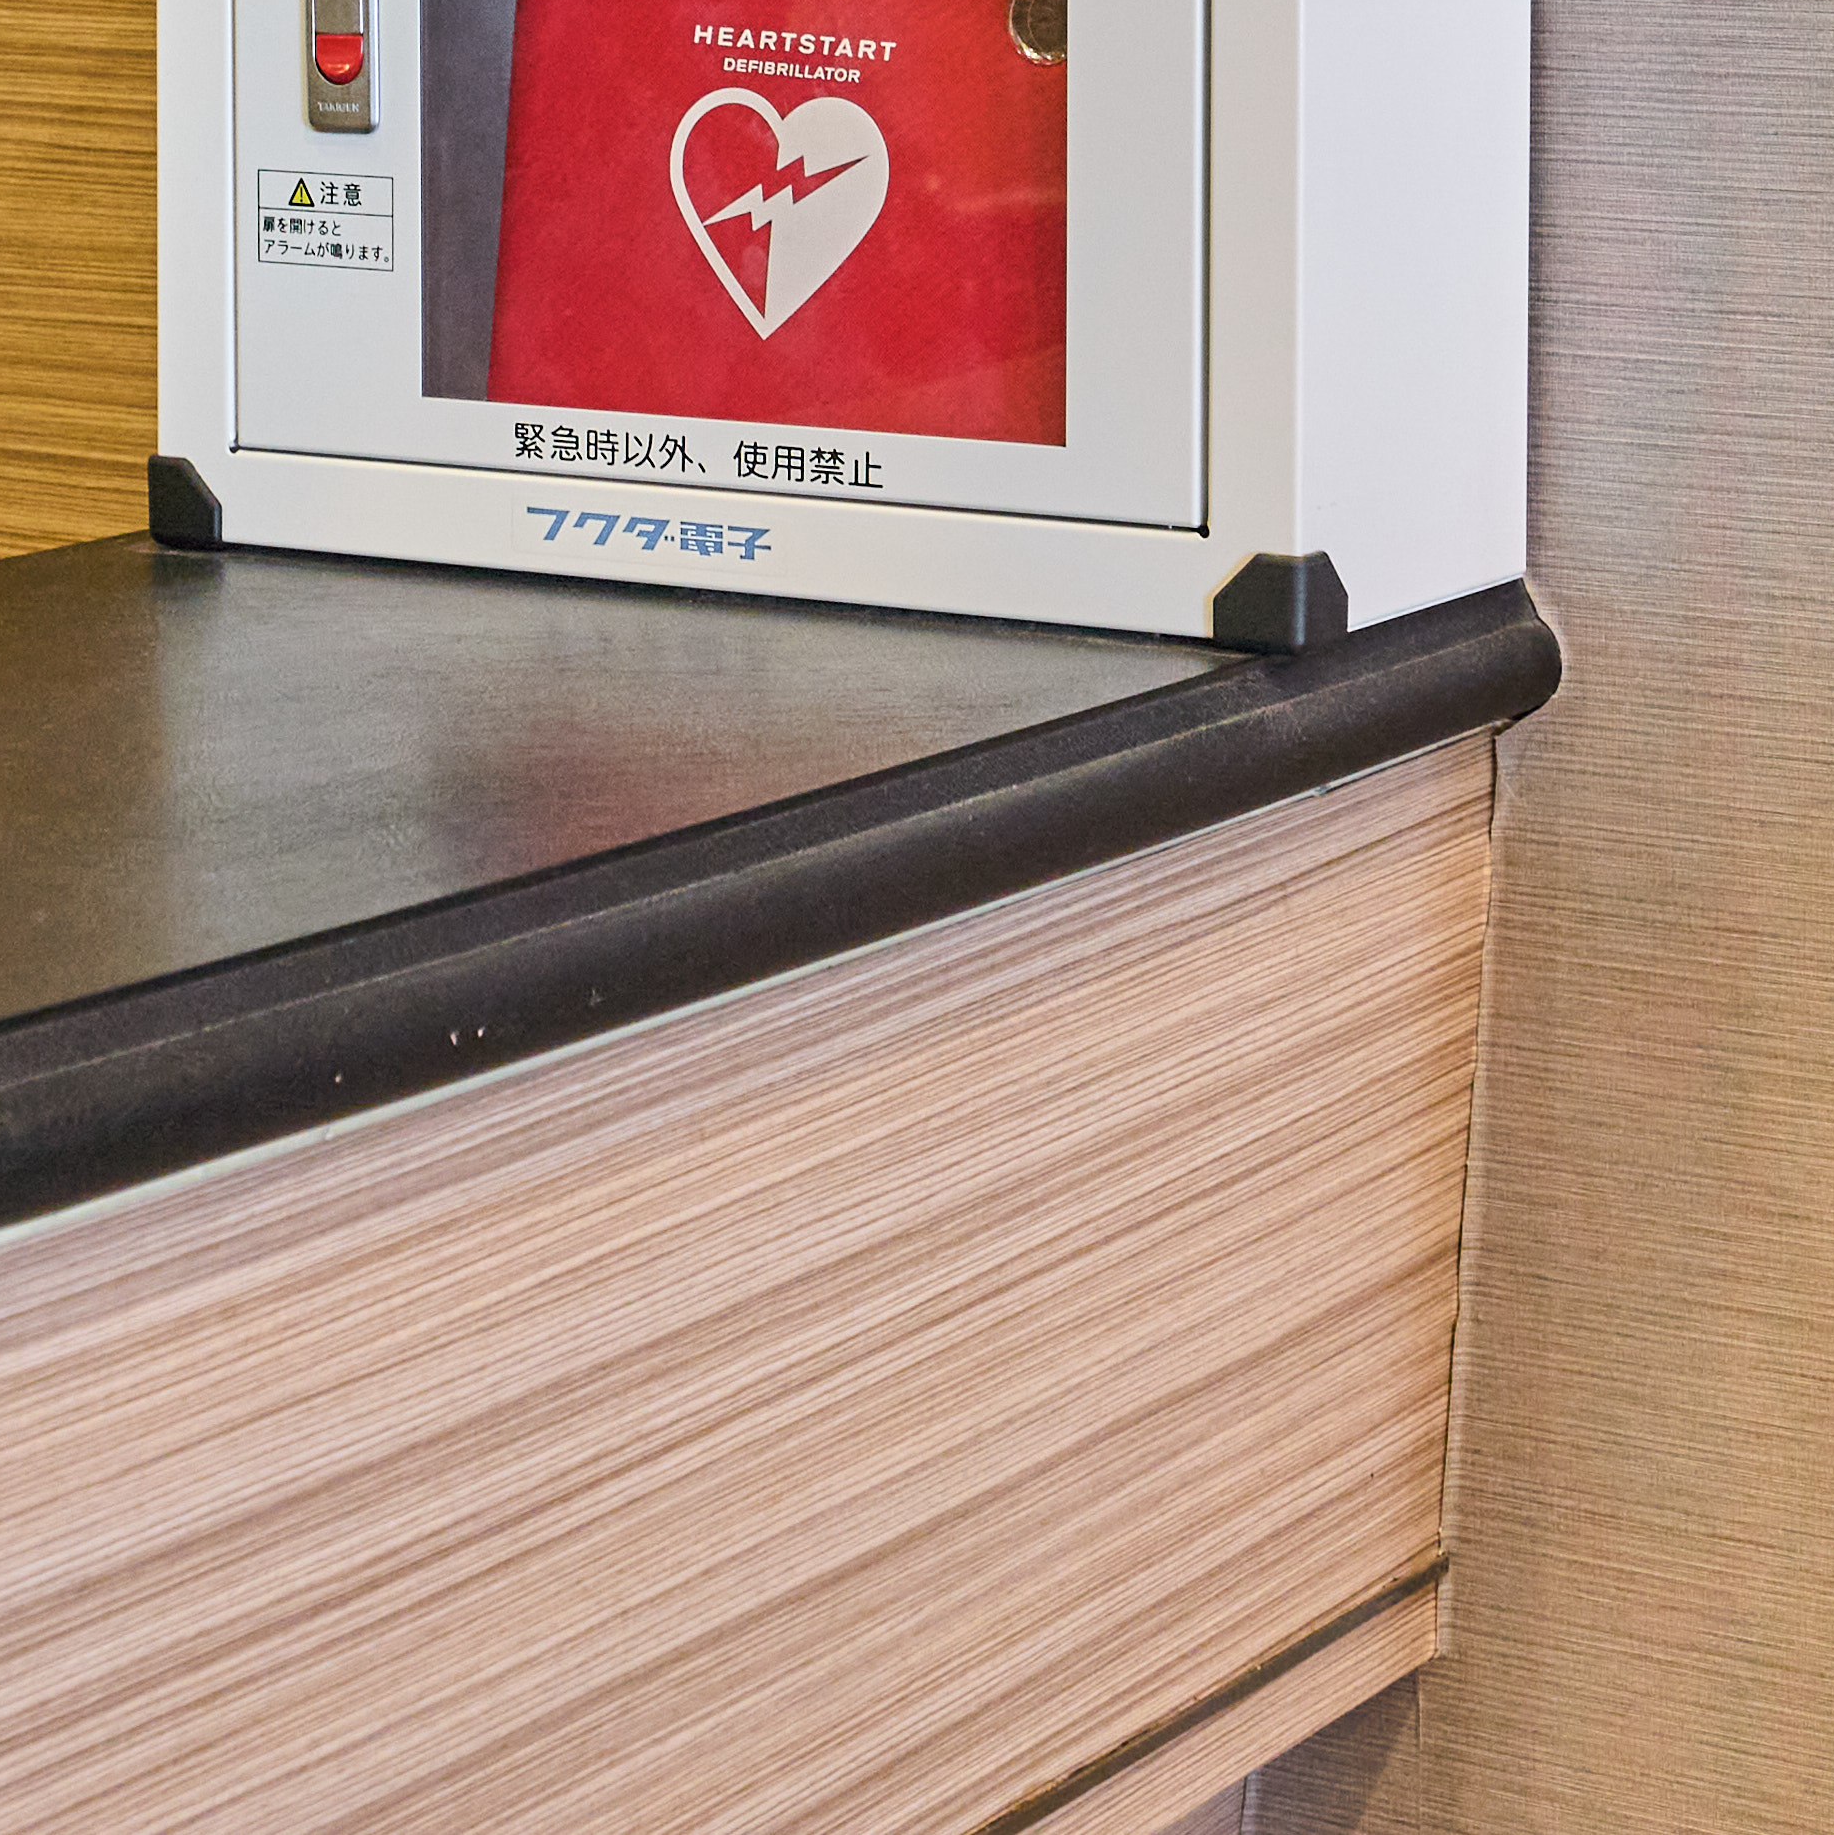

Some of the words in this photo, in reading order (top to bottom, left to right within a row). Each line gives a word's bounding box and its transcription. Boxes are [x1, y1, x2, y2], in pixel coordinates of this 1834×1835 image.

[693, 24, 897, 61] HEARTSTART
[723, 57, 860, 83] DEFIBRILLATOR
[320, 181, 362, 207] 注意
[262, 216, 342, 237] 扉を開けると
[263, 239, 389, 263] アラームが鳴ります。
[514, 422, 884, 489] 緊急時以外、使用禁止
[526, 506, 771, 560] フクダ電子
